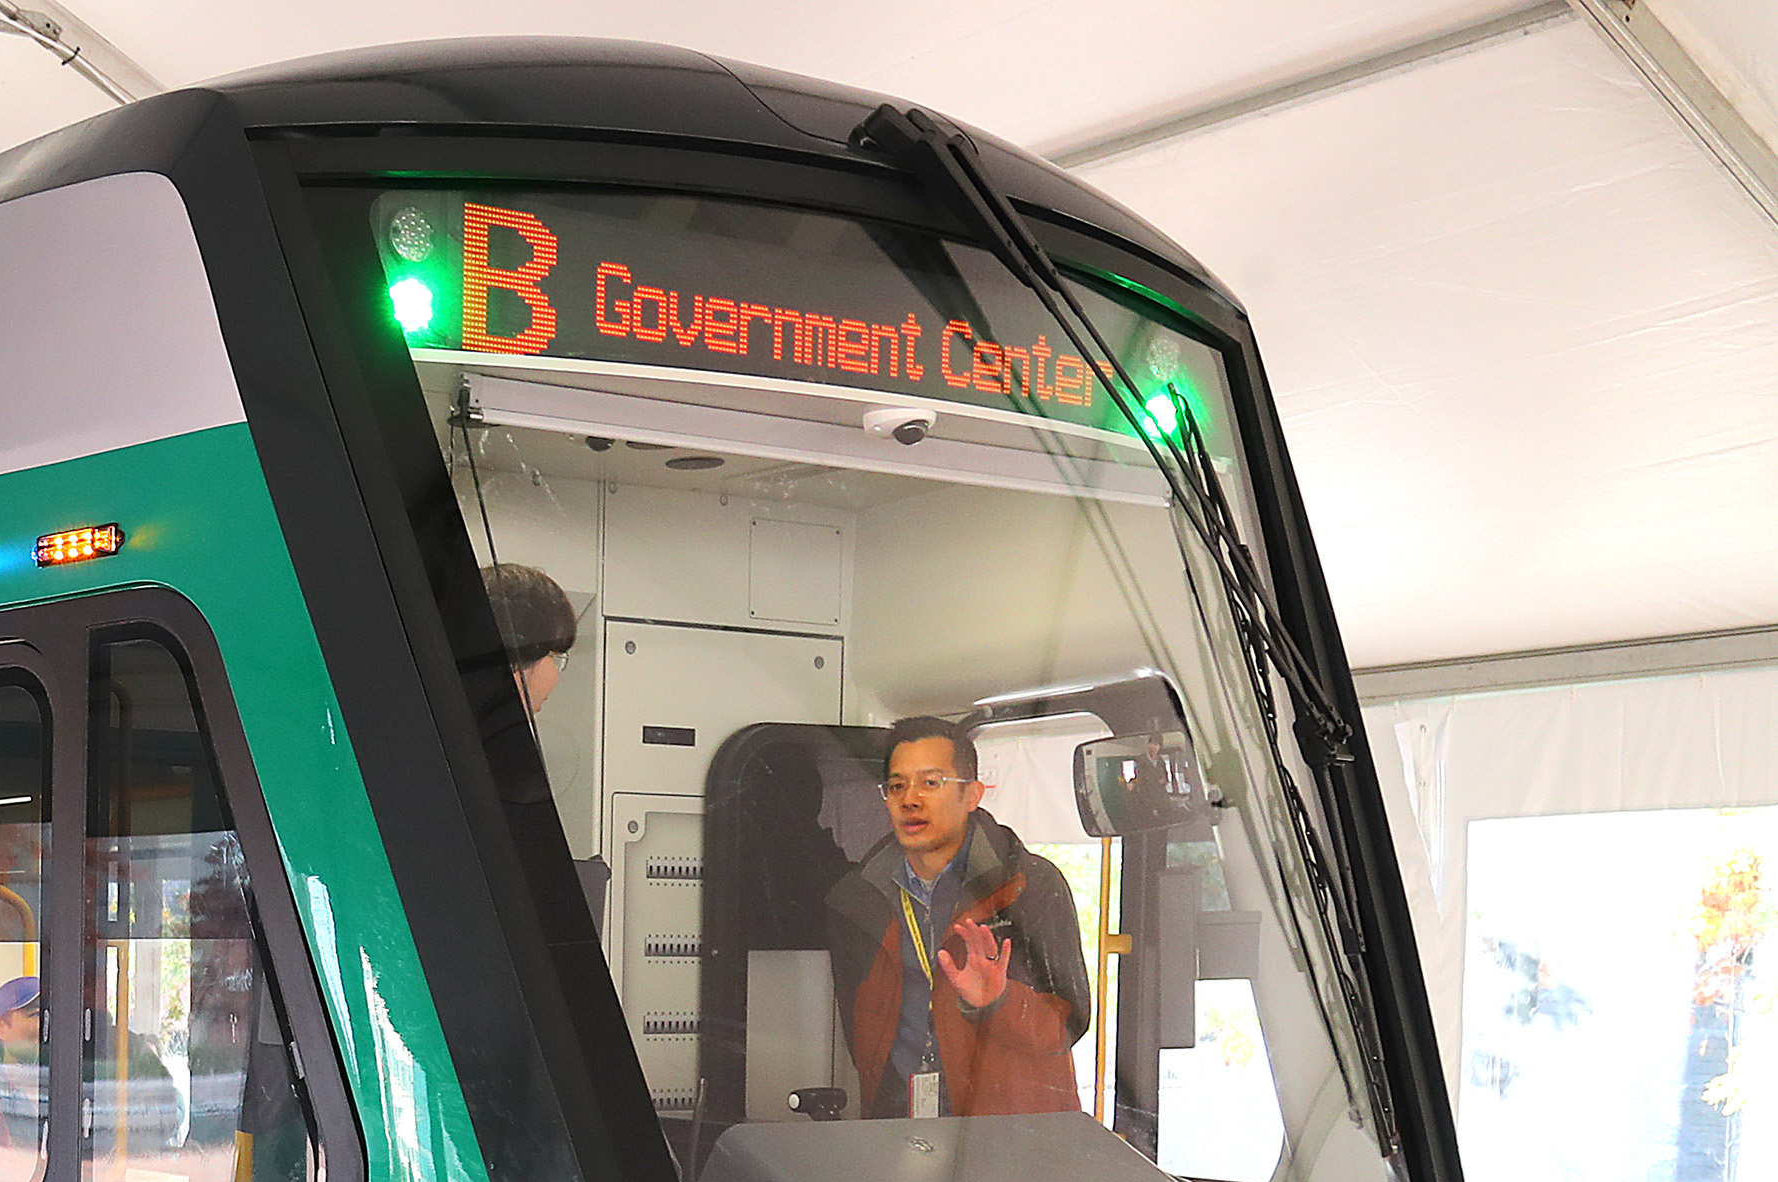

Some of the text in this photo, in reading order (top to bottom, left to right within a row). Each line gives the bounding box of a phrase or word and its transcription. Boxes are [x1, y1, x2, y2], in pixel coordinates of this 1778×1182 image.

[461, 201, 559, 358] B
[594, 260, 1116, 409] Government Center
